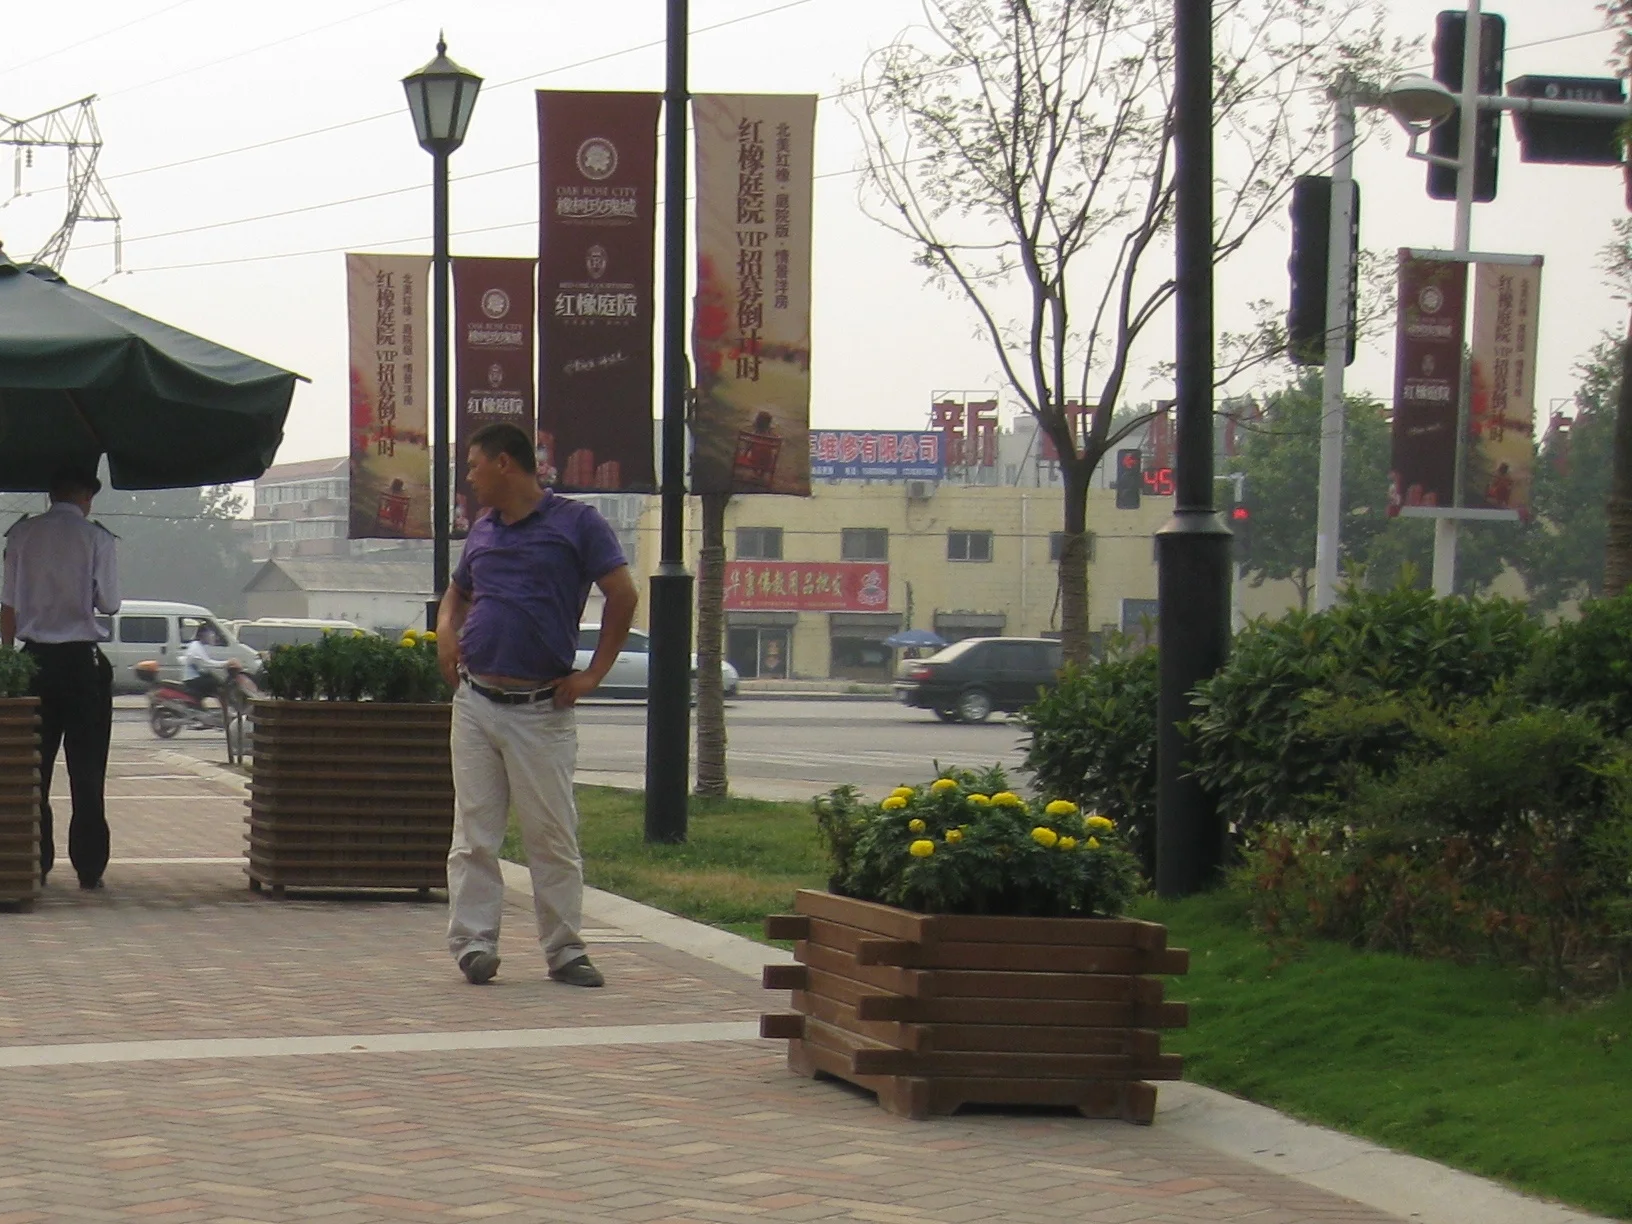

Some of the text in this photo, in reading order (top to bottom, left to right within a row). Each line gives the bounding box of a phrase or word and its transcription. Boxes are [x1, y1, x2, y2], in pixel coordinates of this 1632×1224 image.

[556, 186, 579, 196] OAK
[611, 186, 638, 196] CITY
[555, 293, 638, 318] 红橡庭院
[1143, 467, 1176, 496] 45
